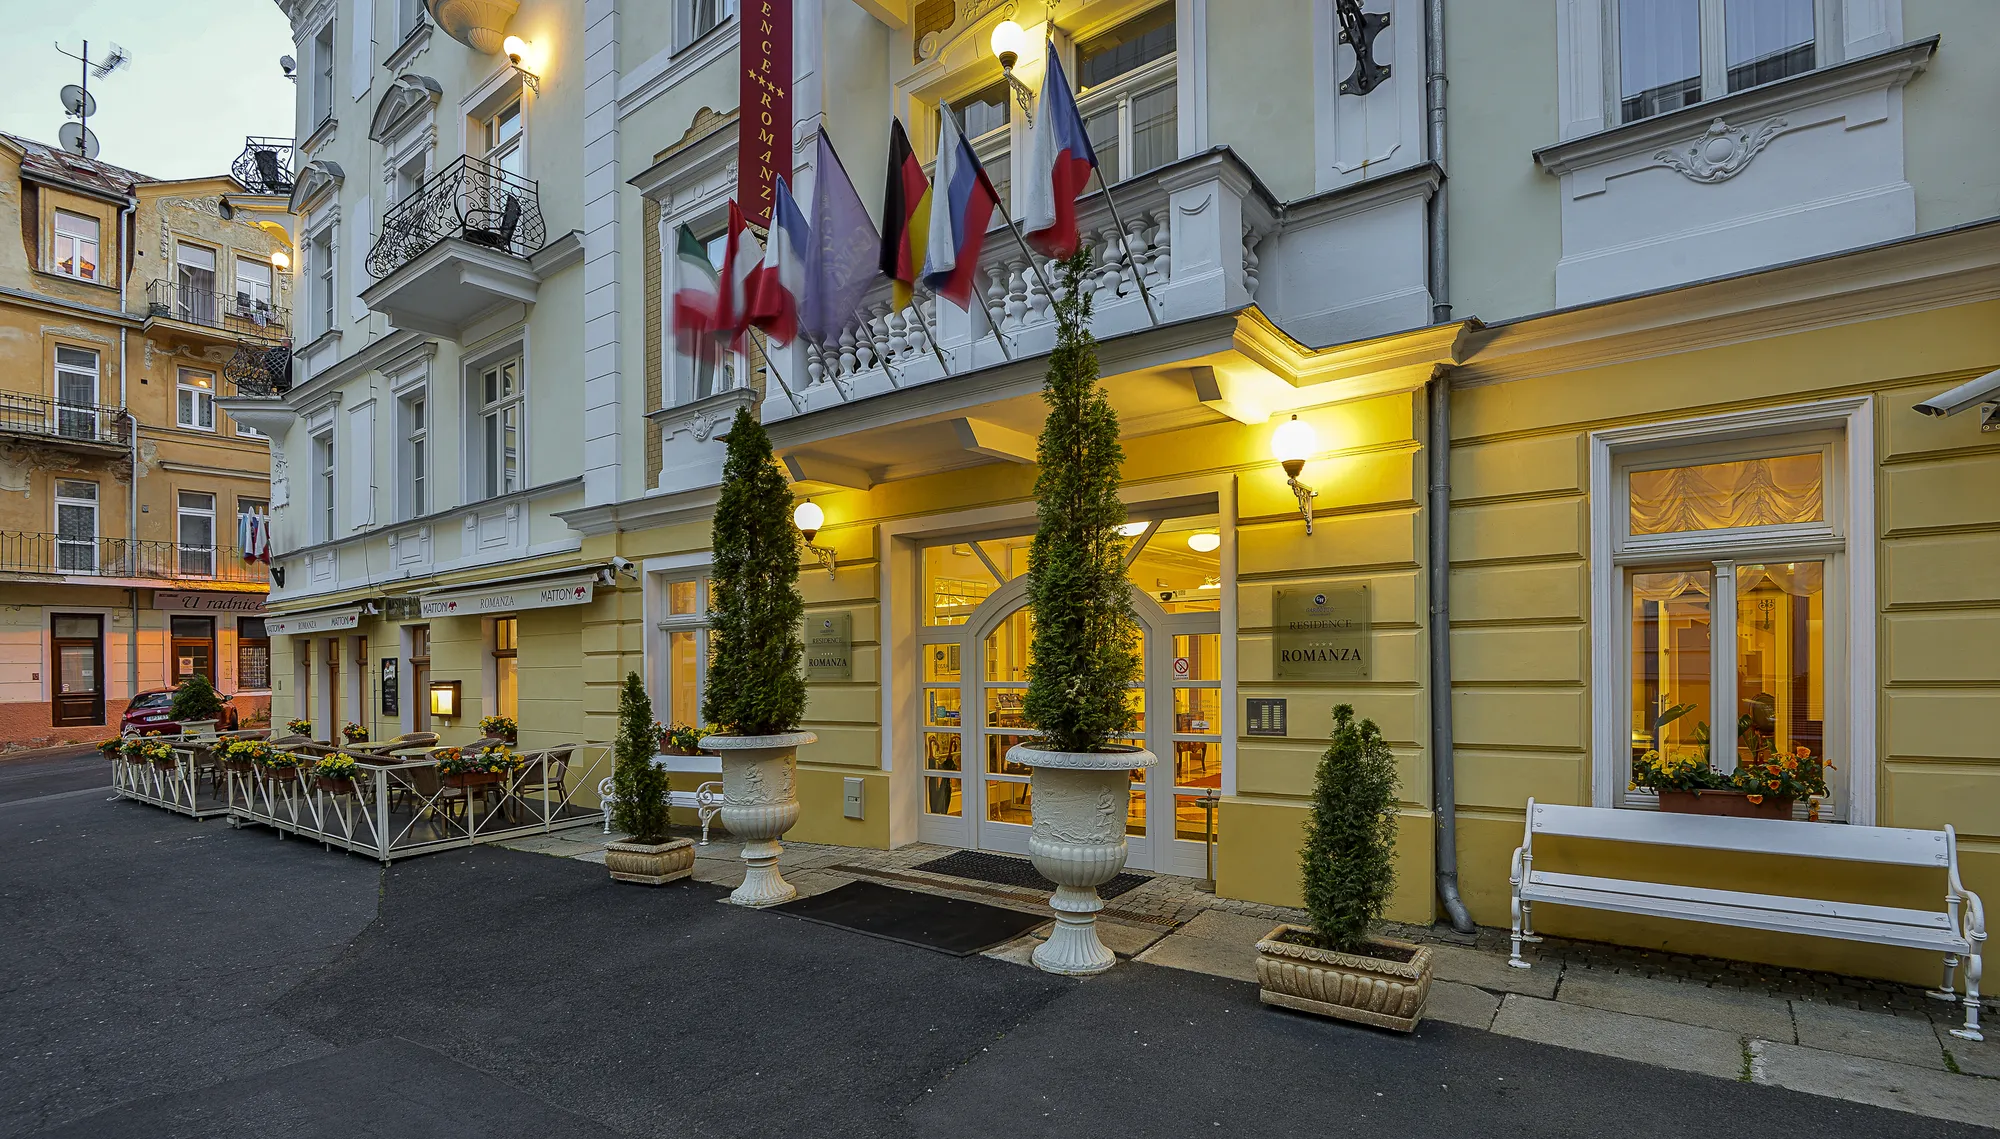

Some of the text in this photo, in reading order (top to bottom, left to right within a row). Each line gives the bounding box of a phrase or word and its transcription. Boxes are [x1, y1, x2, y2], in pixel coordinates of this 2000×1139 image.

[758, 92, 774, 219] ROMANZA
[182, 595, 264, 611] U radnice
[423, 587, 573, 614] MATTONI ROMANZA MATTONI
[297, 620, 317, 630] ROMANZA
[330, 615, 349, 627] MATTONI
[1289, 619, 1352, 630] RESIDENCE
[812, 636, 842, 645] RESIDENCE
[808, 657, 847, 667] ROMANZA
[1281, 648, 1362, 662] ROMANZA
